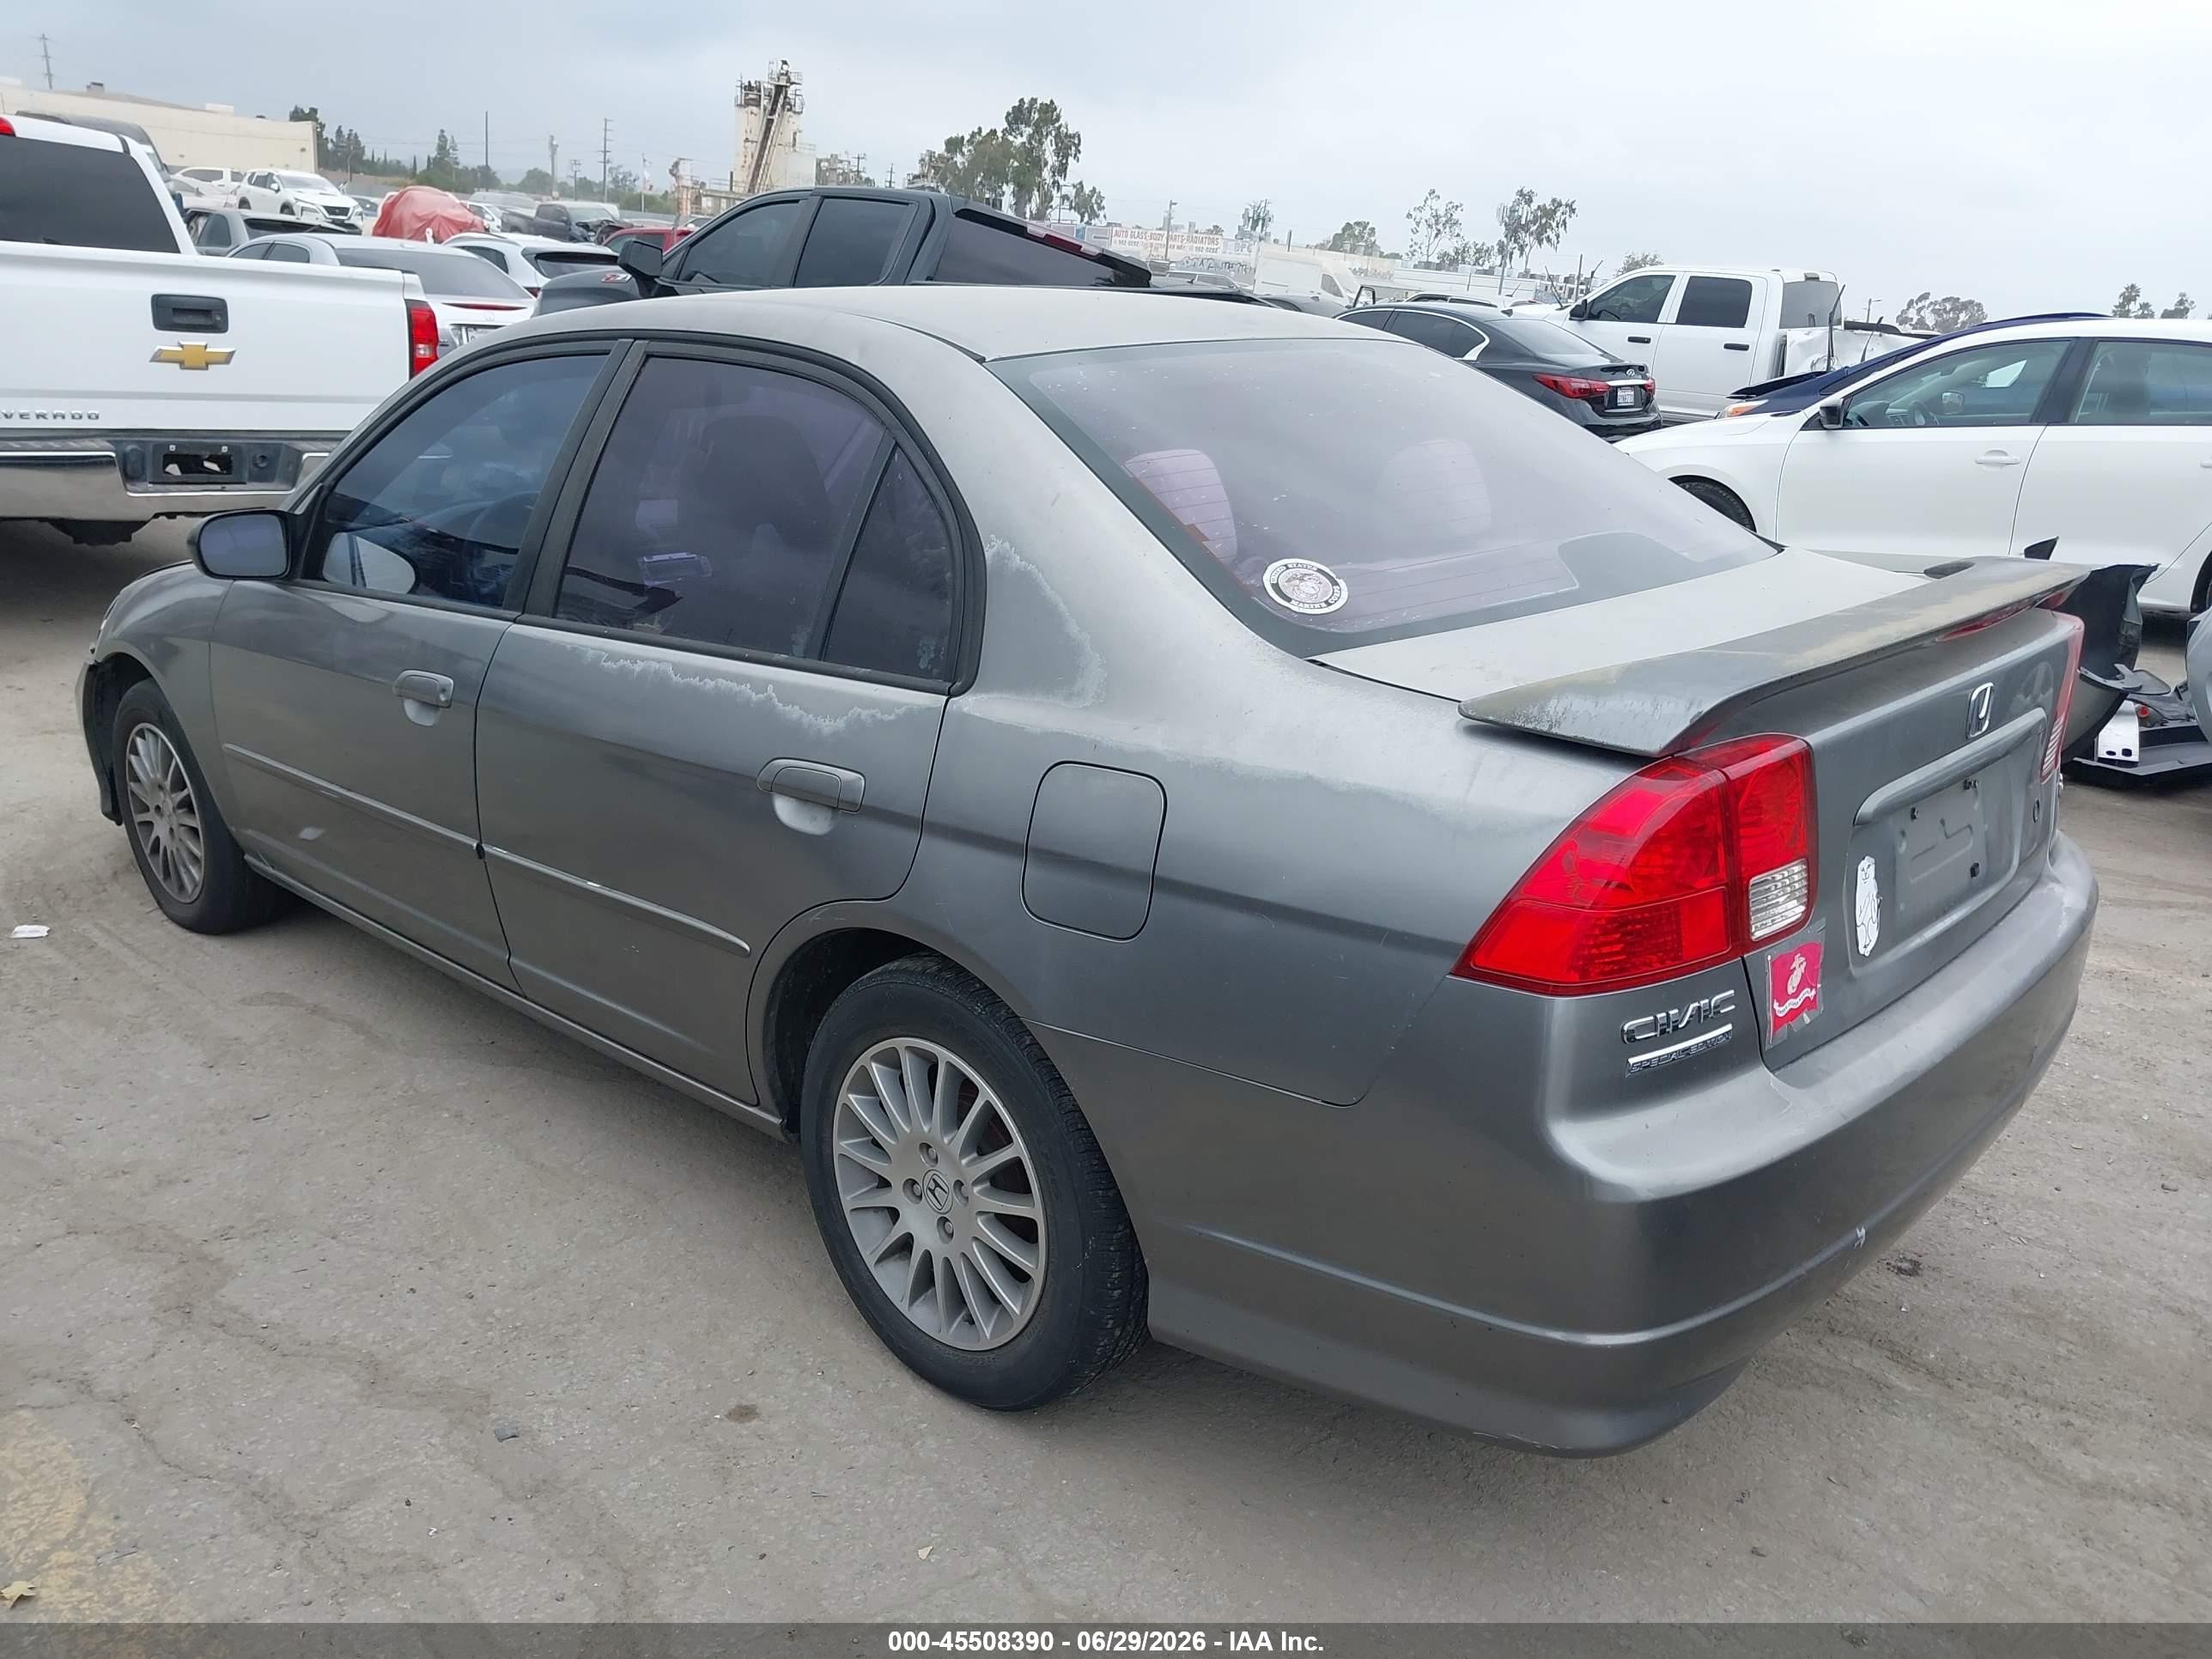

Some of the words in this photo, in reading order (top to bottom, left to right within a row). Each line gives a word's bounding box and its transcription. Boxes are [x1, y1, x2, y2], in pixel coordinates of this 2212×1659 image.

[1114, 229, 1128, 239] AUTO
[0, 410, 100, 420] VERADO
[1621, 989, 1735, 1044] CIVIC
[1631, 1050, 1686, 1073] SPECIAL
[1688, 1031, 1733, 1055] EDITION
